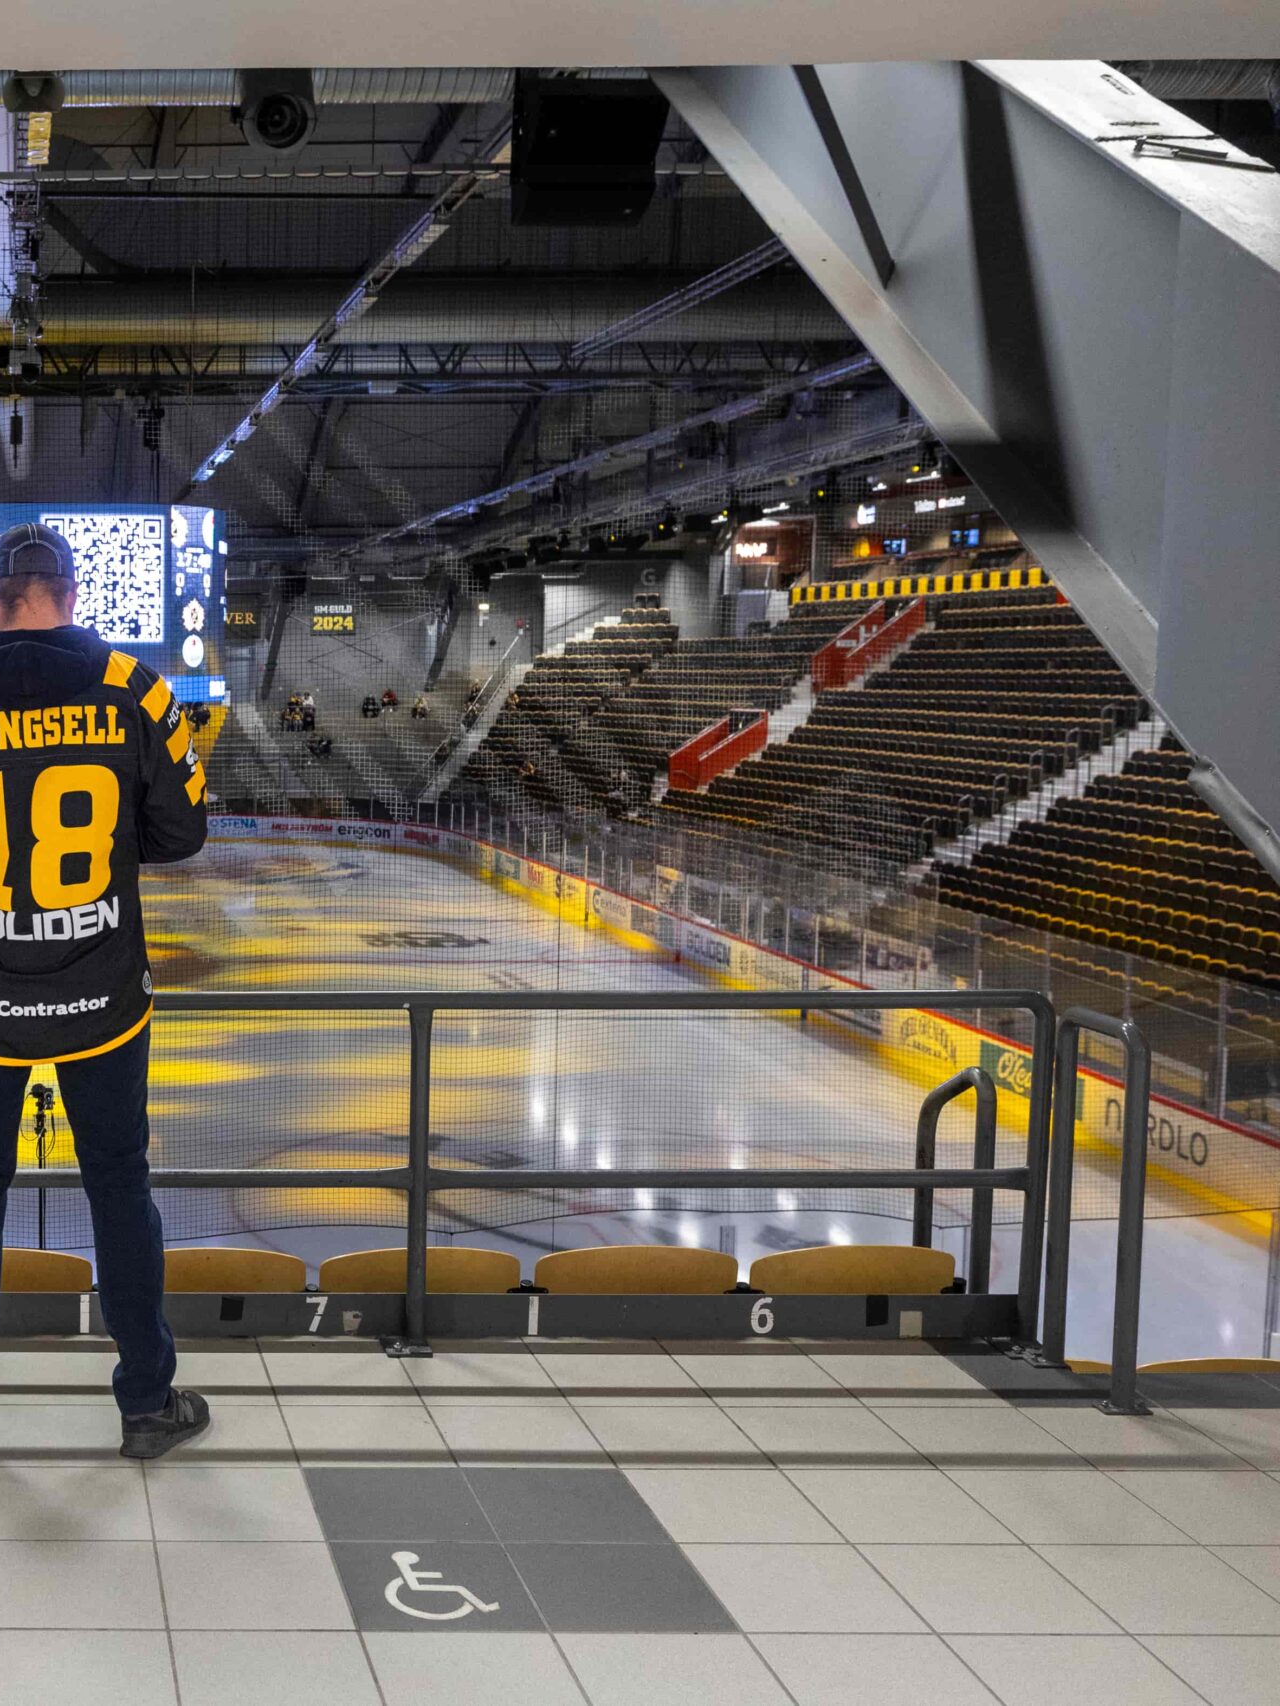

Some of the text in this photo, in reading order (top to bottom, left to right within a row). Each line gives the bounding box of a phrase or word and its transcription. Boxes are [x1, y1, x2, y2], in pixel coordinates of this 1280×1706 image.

[640, 568, 657, 586] G
[225, 612, 257, 625] VER
[313, 616, 354, 631] 2024
[220, 818, 257, 829] STENA
[306, 1296, 328, 1332] 7
[750, 1297, 775, 1334] 6
